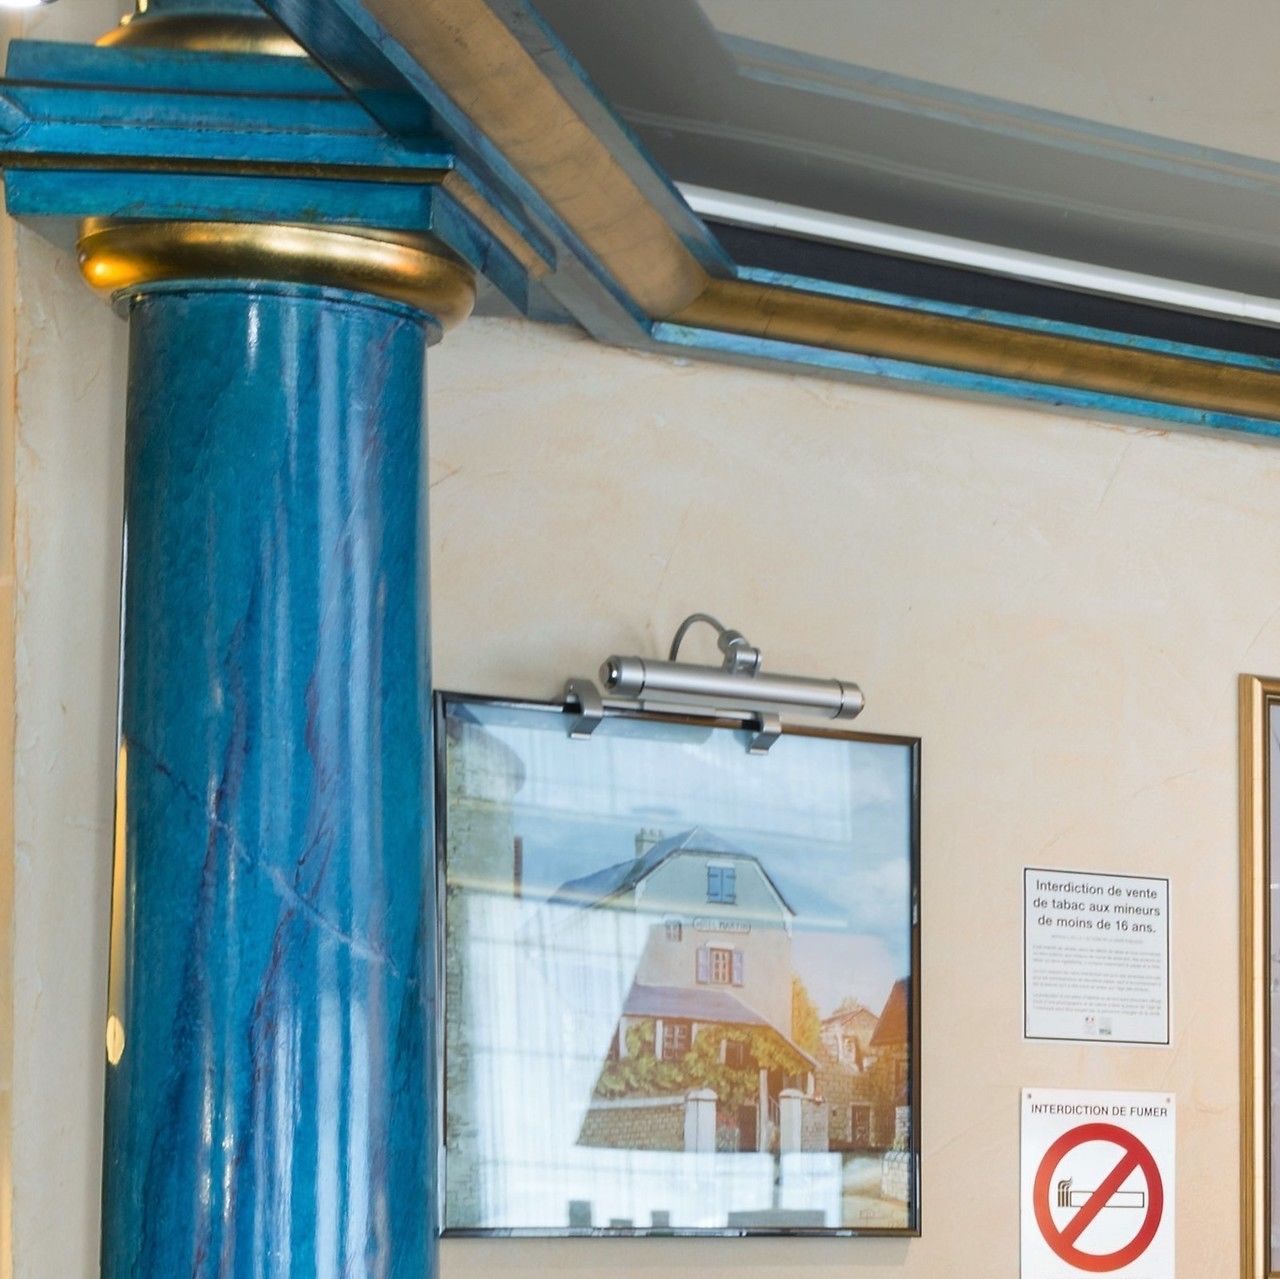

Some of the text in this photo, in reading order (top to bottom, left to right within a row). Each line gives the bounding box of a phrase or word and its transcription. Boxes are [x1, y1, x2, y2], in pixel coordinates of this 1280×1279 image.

[1036, 880, 1158, 899] Interdiction de vente
[1033, 898, 1160, 916] de tabac aux mineurs
[1038, 915, 1156, 933] de moins de 16 ans.
[1031, 1104, 1168, 1117] INTERDICTION DE FUMER
